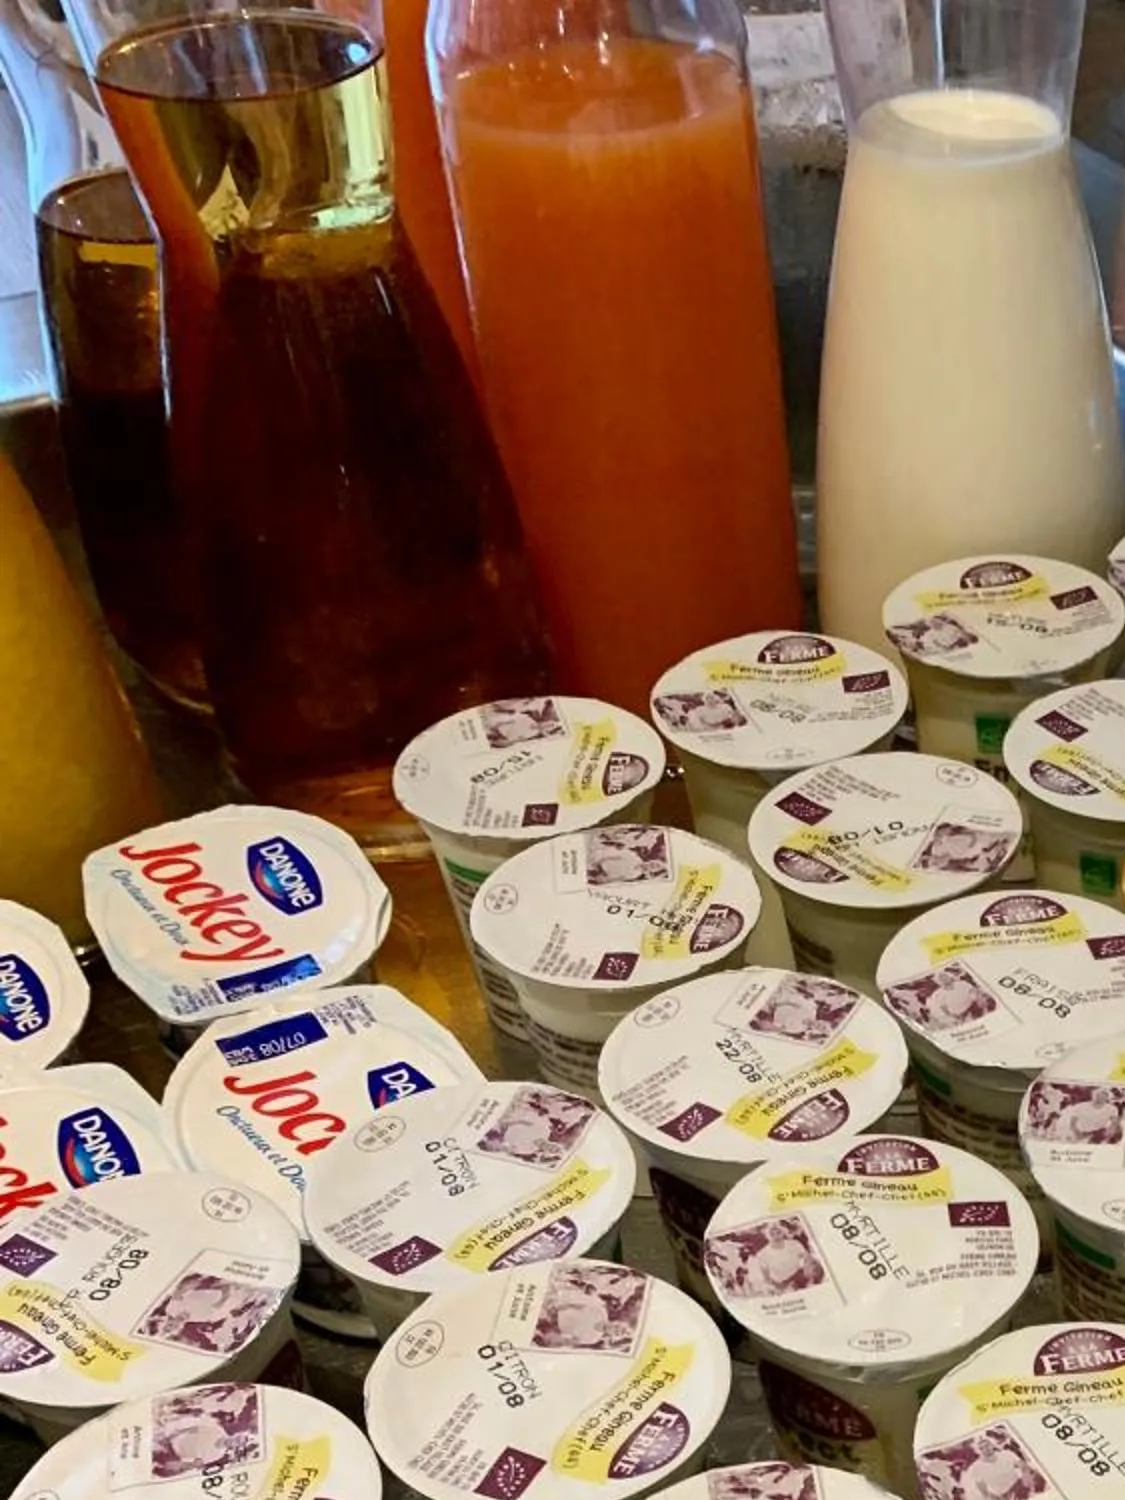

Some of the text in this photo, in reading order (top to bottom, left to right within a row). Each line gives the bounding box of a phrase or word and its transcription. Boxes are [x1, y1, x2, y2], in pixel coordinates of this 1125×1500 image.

[761, 645, 835, 663] FERME
[119, 842, 285, 962] Jockey
[985, 904, 1066, 925] FERME
[952, 928, 1000, 942] Ferme
[998, 974, 1071, 1019] 08/08
[716, 1039, 763, 1083] 22/08
[224, 1070, 346, 1156] Joc
[425, 1141, 464, 1197] 01/08
[442, 1137, 479, 1190] CITRON
[802, 1174, 919, 1192] Ferme Gineau
[846, 1155, 930, 1175] FERME
[830, 1212, 886, 1282] 08/08
[89, 1248, 149, 1302] 08/08
[478, 1343, 525, 1408] 01/08
[497, 1340, 542, 1400] CITRON
[999, 1374, 1124, 1395] Ferme Gineau
[594, 1370, 676, 1452] Ferme Gineau
[614, 1413, 676, 1473] FERME
[1041, 1413, 1109, 1478] 08/08
